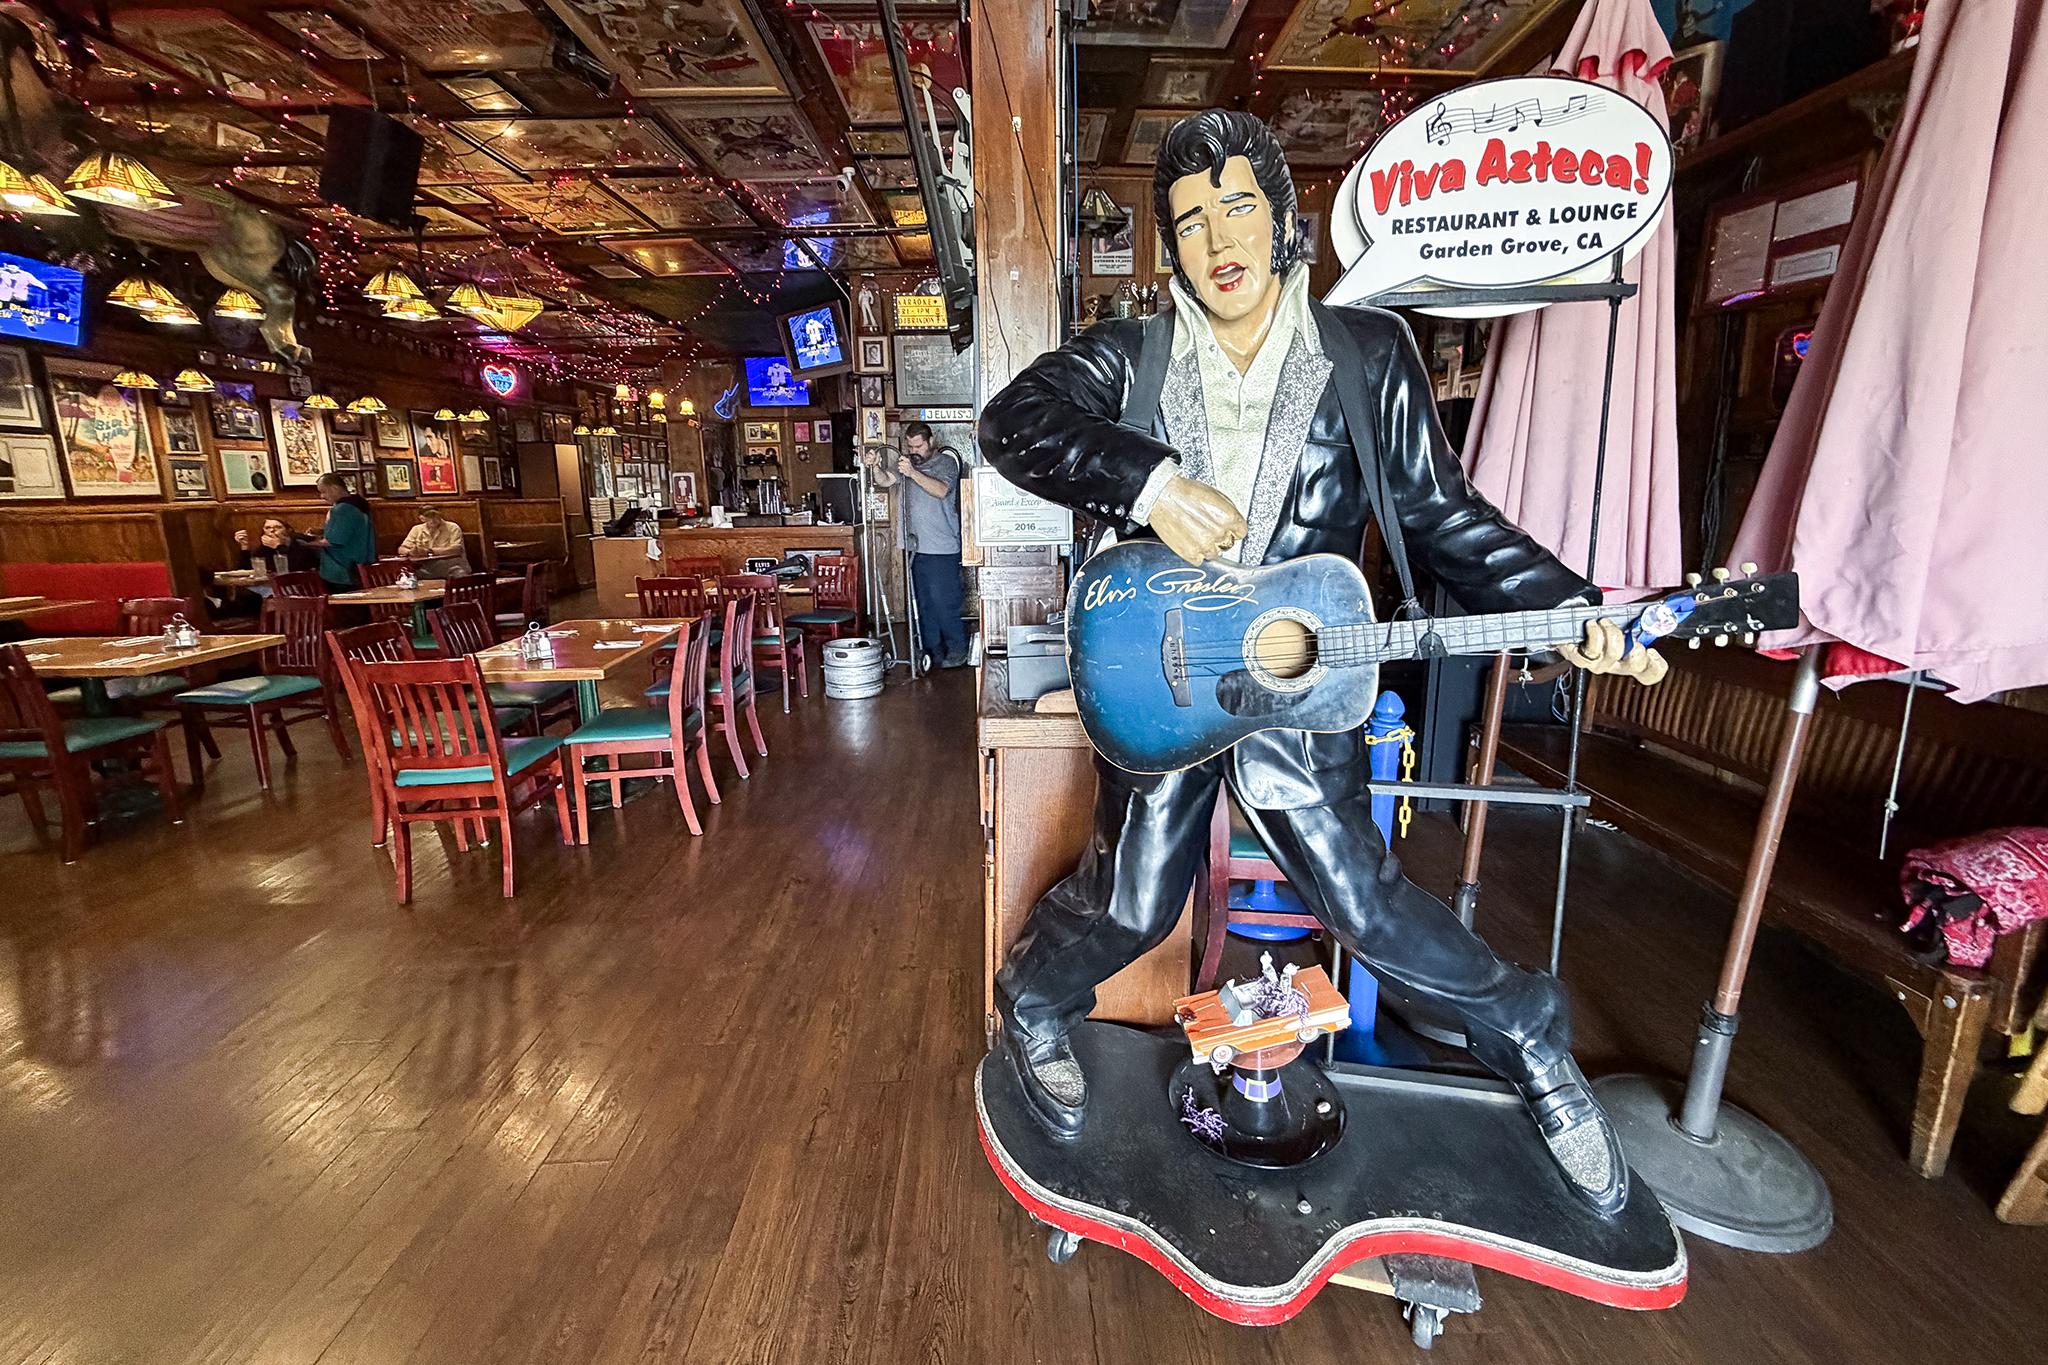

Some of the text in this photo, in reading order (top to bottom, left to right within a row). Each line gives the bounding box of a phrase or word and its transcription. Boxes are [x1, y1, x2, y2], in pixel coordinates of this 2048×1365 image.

[1370, 138, 1653, 215] Viva Azteca!
[1391, 202, 1638, 235] RESTAURANT & LOUNGE
[1420, 232, 1603, 260] Garden Grove, CA
[9, 303, 72, 323] Directed By
[1014, 523, 1036, 531] 2016
[1084, 567, 1259, 612] Elvis Presley
